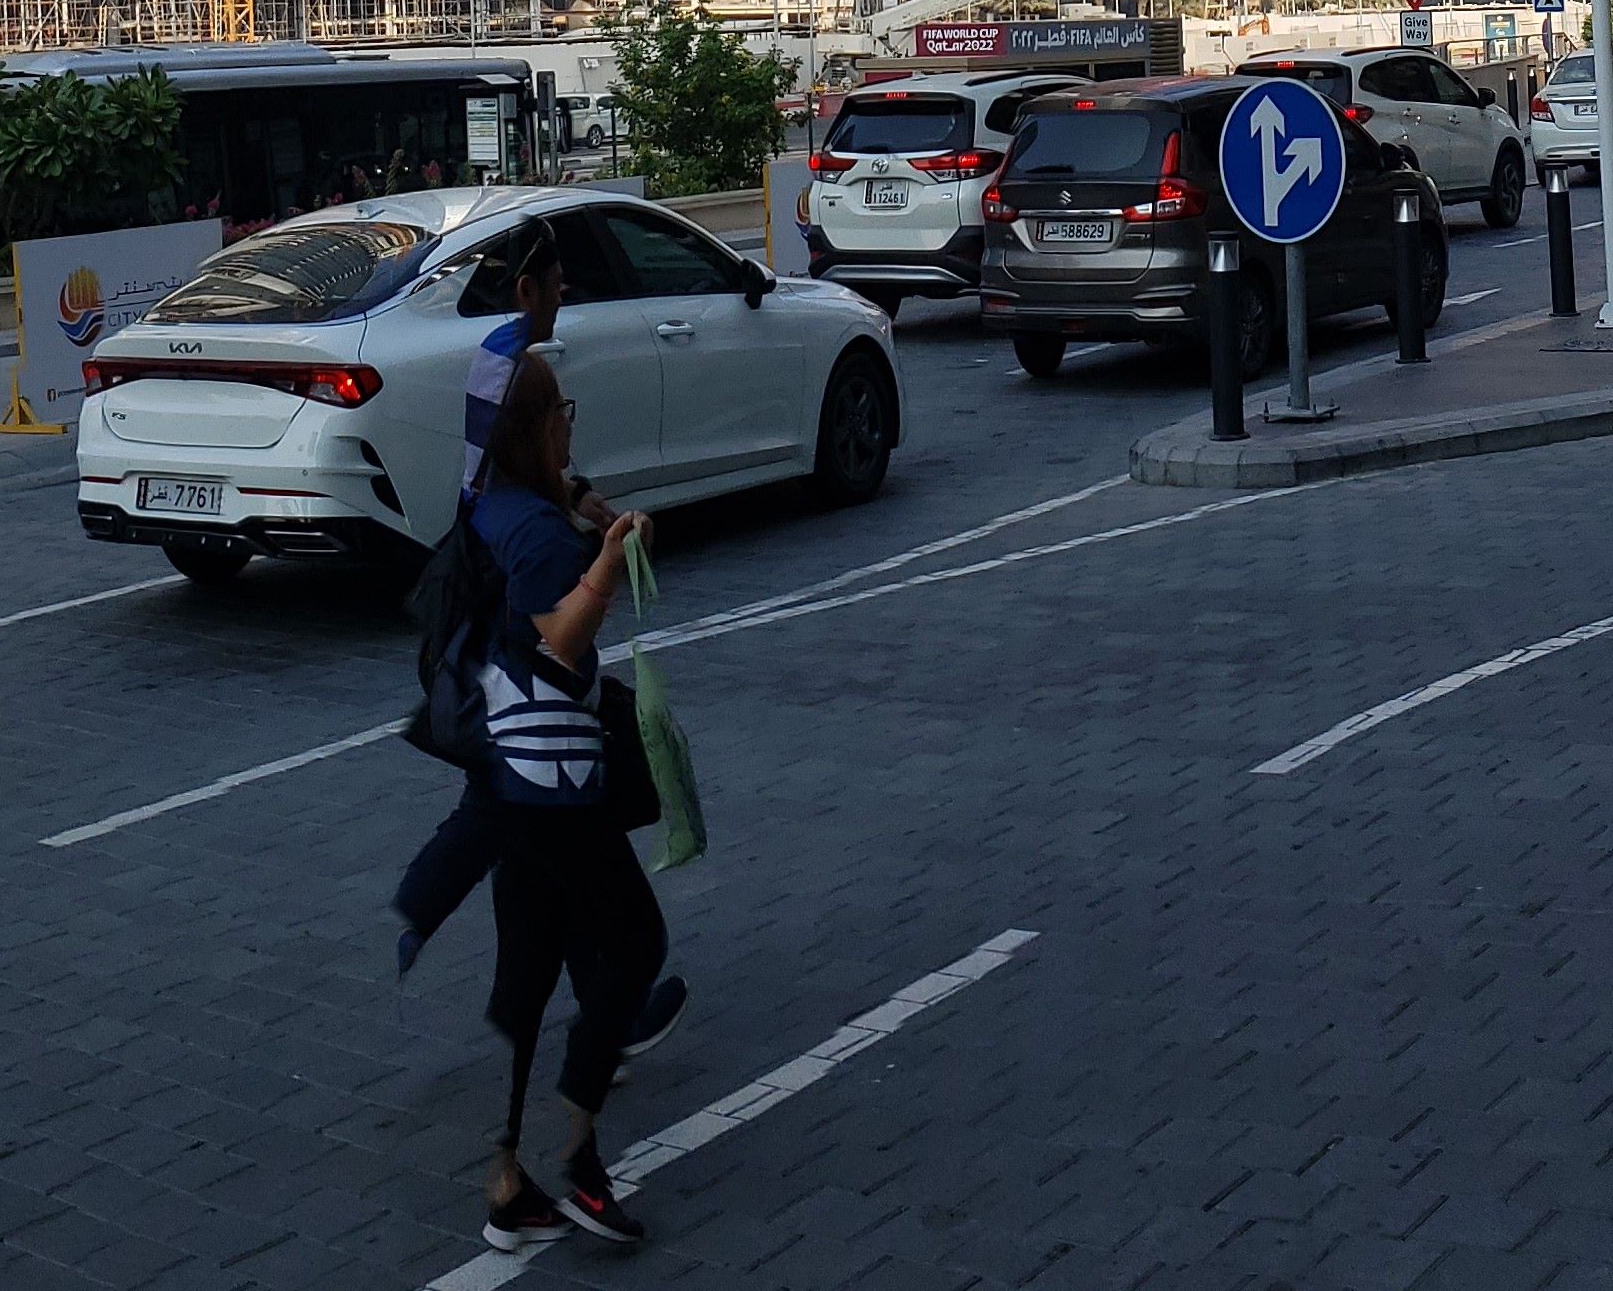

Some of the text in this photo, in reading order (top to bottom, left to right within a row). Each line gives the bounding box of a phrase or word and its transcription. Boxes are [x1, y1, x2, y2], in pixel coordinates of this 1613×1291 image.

[1404, 16, 1428, 27] Give
[923, 28, 999, 39] FIFA WORLD CUP
[1405, 30, 1428, 41] Way
[1061, 224, 1104, 238] 588629
[168, 342, 203, 354] KIA
